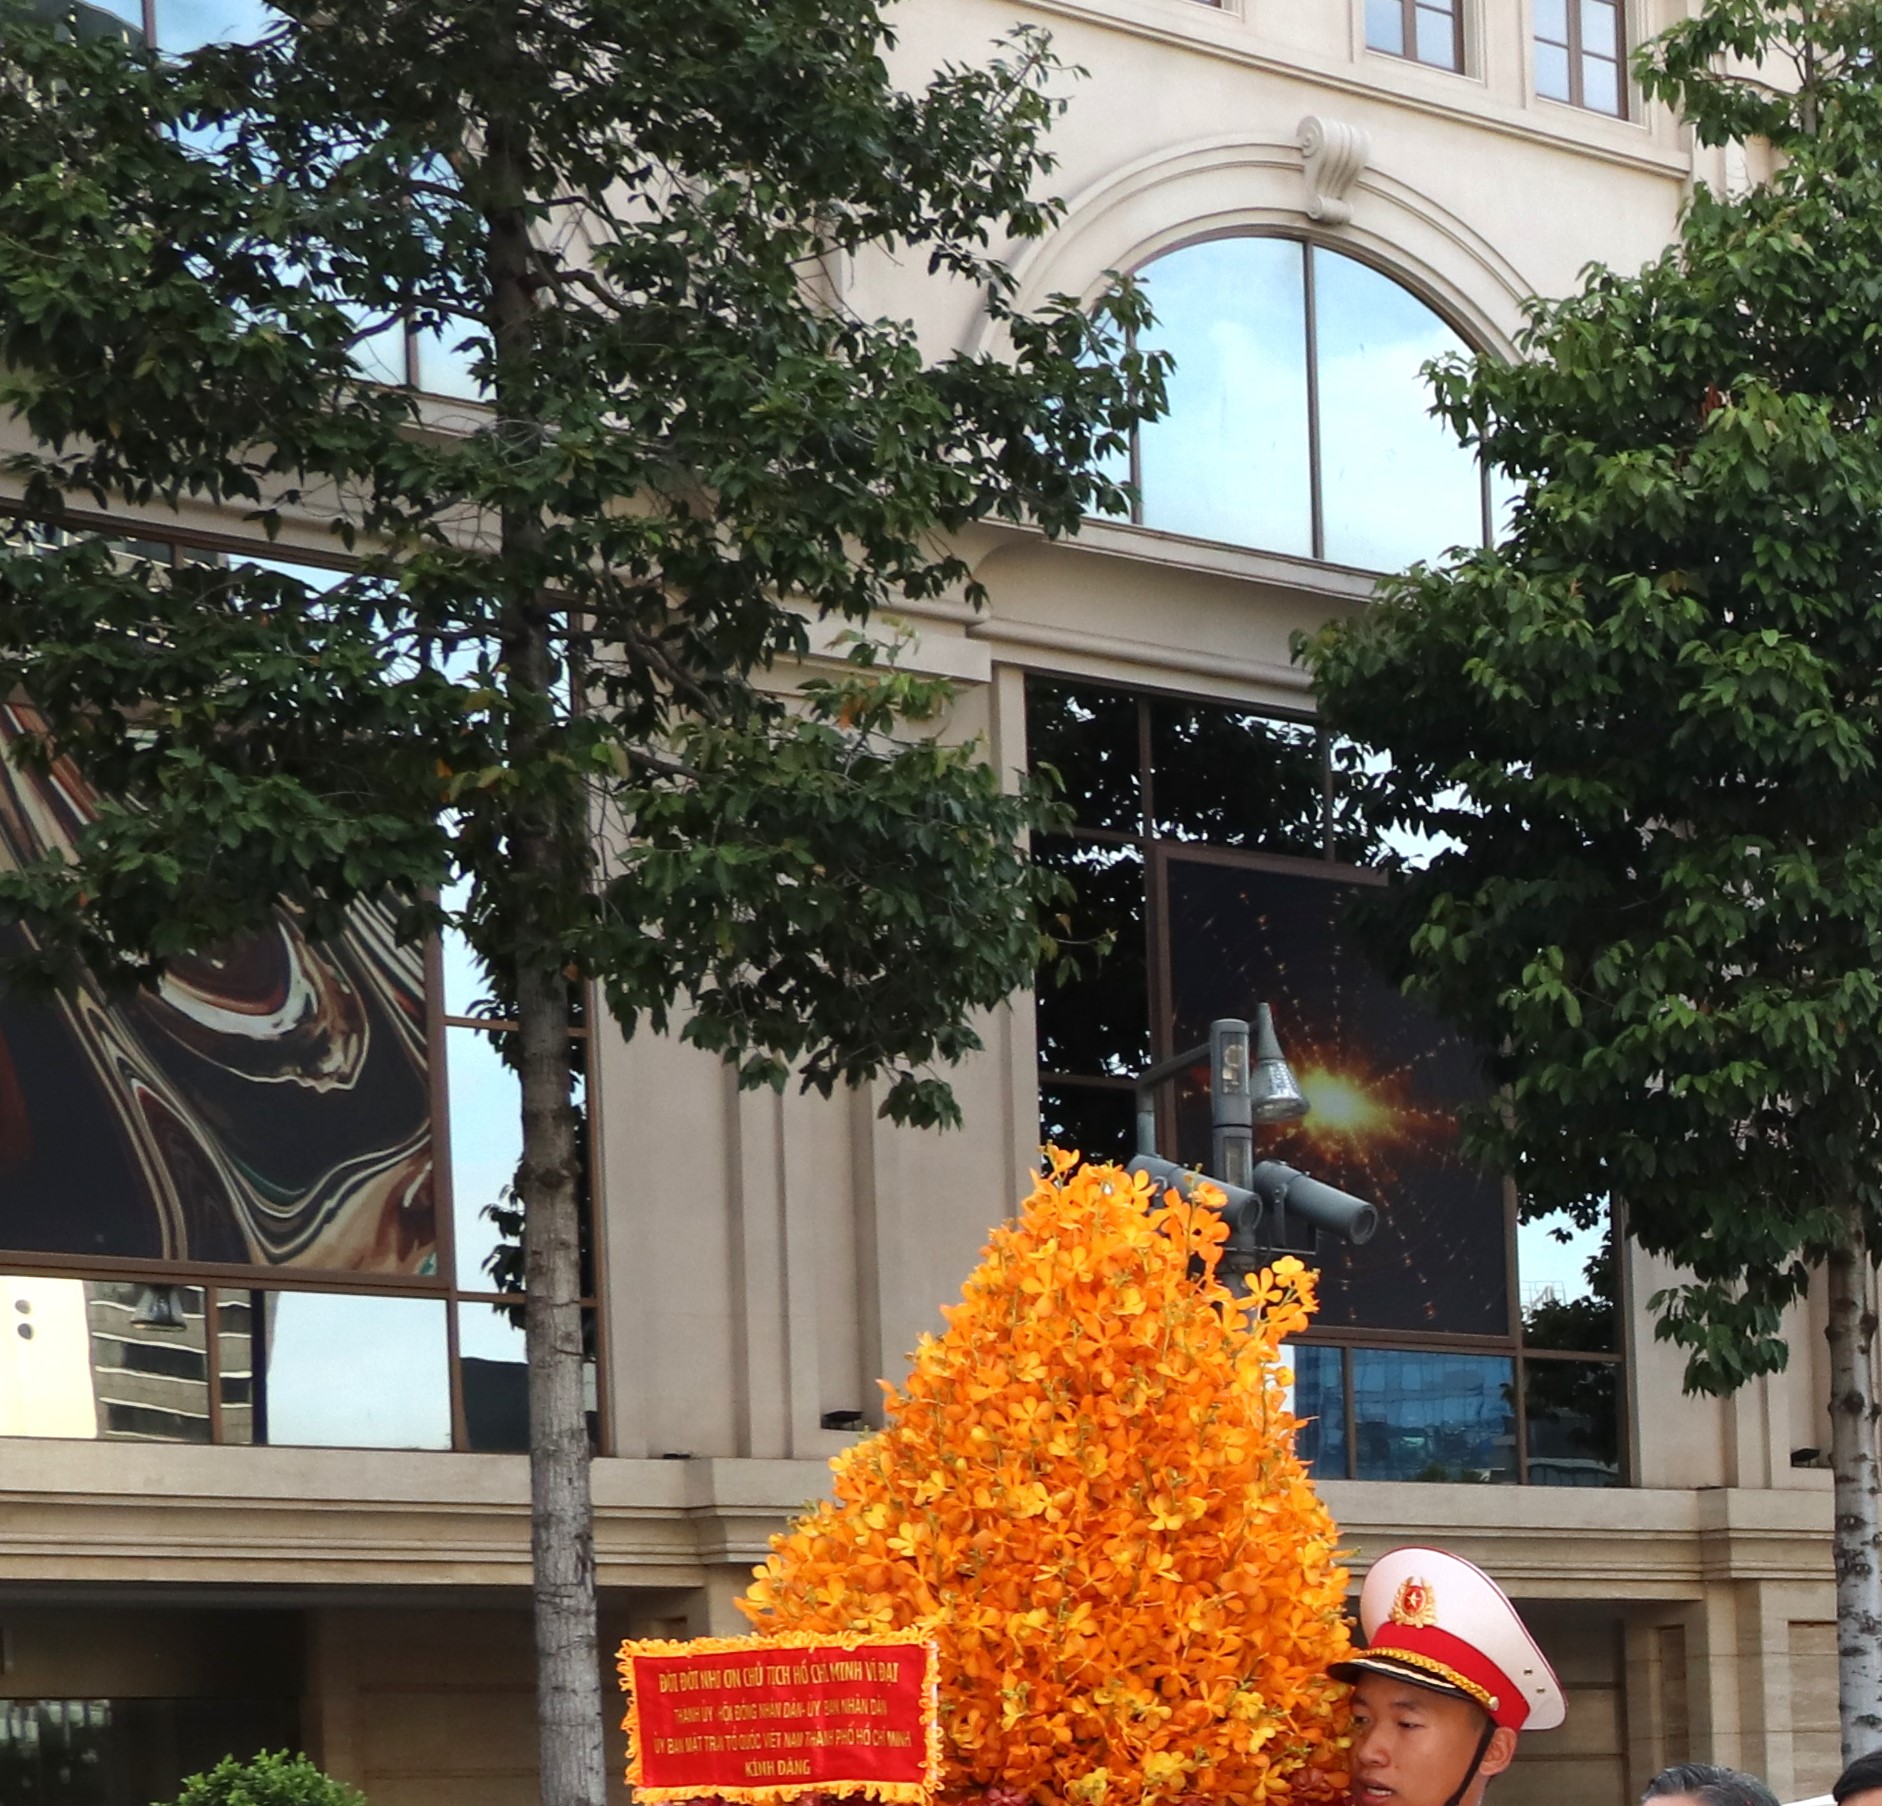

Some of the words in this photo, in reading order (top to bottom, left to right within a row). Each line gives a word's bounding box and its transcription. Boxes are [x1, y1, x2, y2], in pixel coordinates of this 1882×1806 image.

[829, 1661, 863, 1682] MINH
[745, 1758, 775, 1777] KÍNH
[777, 1757, 811, 1776] DÂNG
